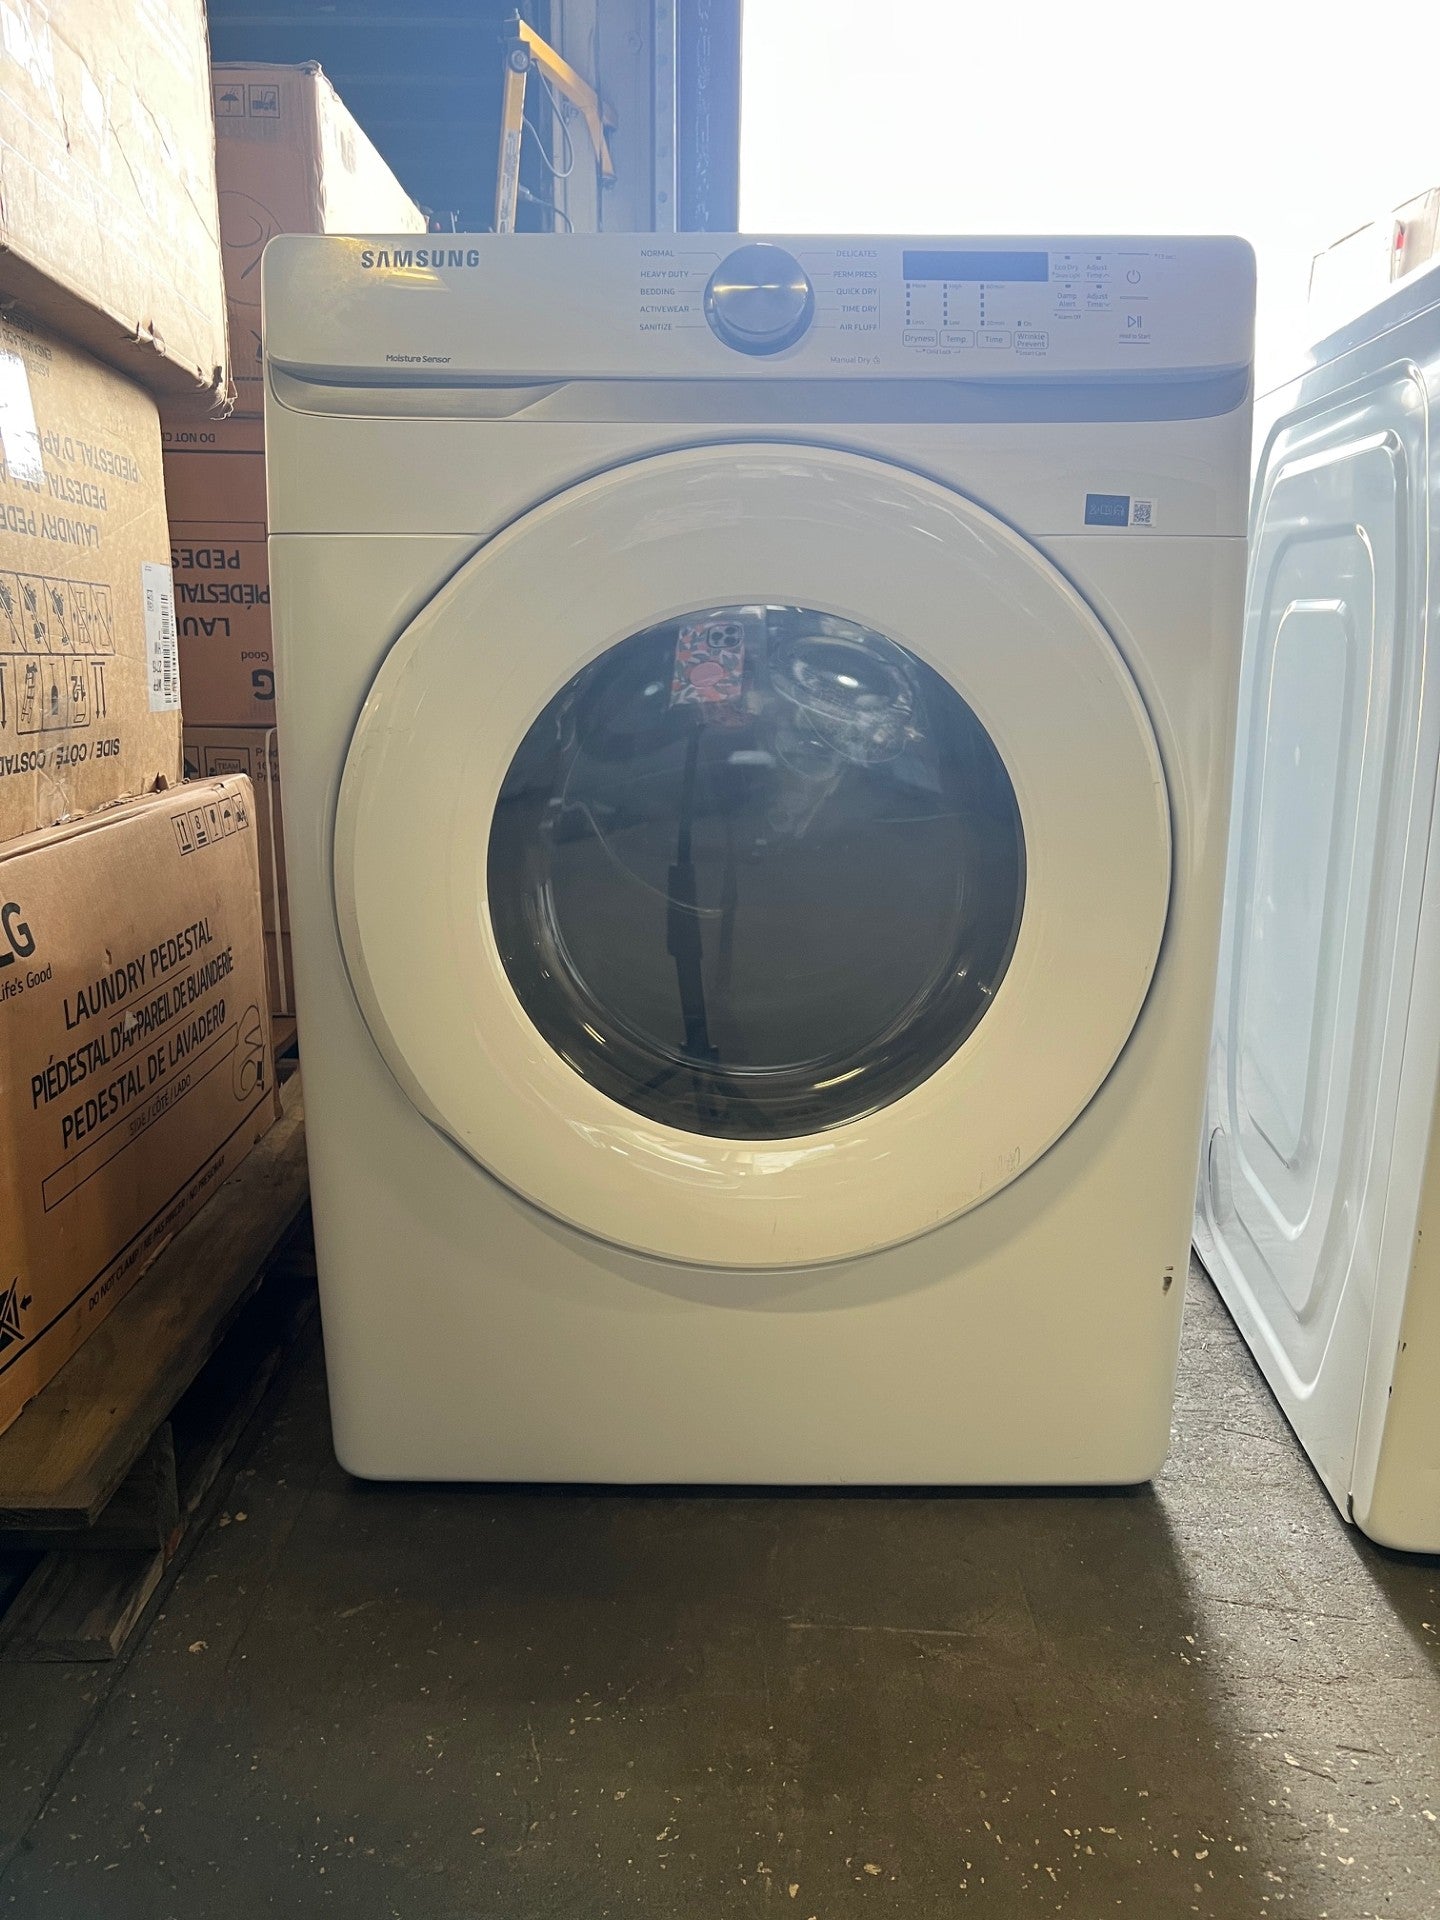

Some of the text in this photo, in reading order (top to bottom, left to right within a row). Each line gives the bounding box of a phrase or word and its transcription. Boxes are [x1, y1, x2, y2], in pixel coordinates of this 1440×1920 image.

[361, 249, 480, 268] SAMSUNG
[640, 249, 675, 257] NORMAL
[835, 250, 878, 258] DELICATES
[640, 270, 689, 279] HEAVY DUTY
[833, 271, 878, 279] PERM PRESS
[640, 288, 676, 296] BEDDING
[836, 288, 878, 296] QUICK DRY
[639, 305, 690, 313] ACTIVEWEAR
[842, 305, 878, 313] TIME DRY
[639, 323, 673, 331] SANITIZE
[904, 335, 936, 344] Dryness
[1017, 332, 1046, 340] Wrinkle
[1017, 340, 1046, 348] Prevent
[385, 353, 451, 364] Moisture Sensor
[830, 356, 871, 366] Manual Dry
[175, 432, 198, 444] NOT
[198, 432, 216, 444] DO
[40, 509, 100, 549] LAUNDRY
[240, 651, 270, 662] Good
[251, 668, 276, 701] G
[96, 737, 120, 759] SIDE
[56, 742, 87, 770] CÔTÉ
[26, 962, 53, 989] Good
[63, 916, 213, 1030] LAUNDRY PEDESTAL
[31, 1037, 111, 1109] PIÉDESTAL
[173, 983, 188, 1012] DE
[187, 946, 234, 1003] BUANDERIE
[61, 1069, 145, 1149] PEDESTAL
[147, 1046, 166, 1083] DE
[168, 998, 226, 1066] LAVADERO
[129, 1111, 147, 1137] SIDE
[173, 1073, 191, 1098] LADO
[88, 1292, 99, 1311] DO
[100, 1275, 116, 1297] NOT
[116, 1249, 139, 1279] CLAMP
